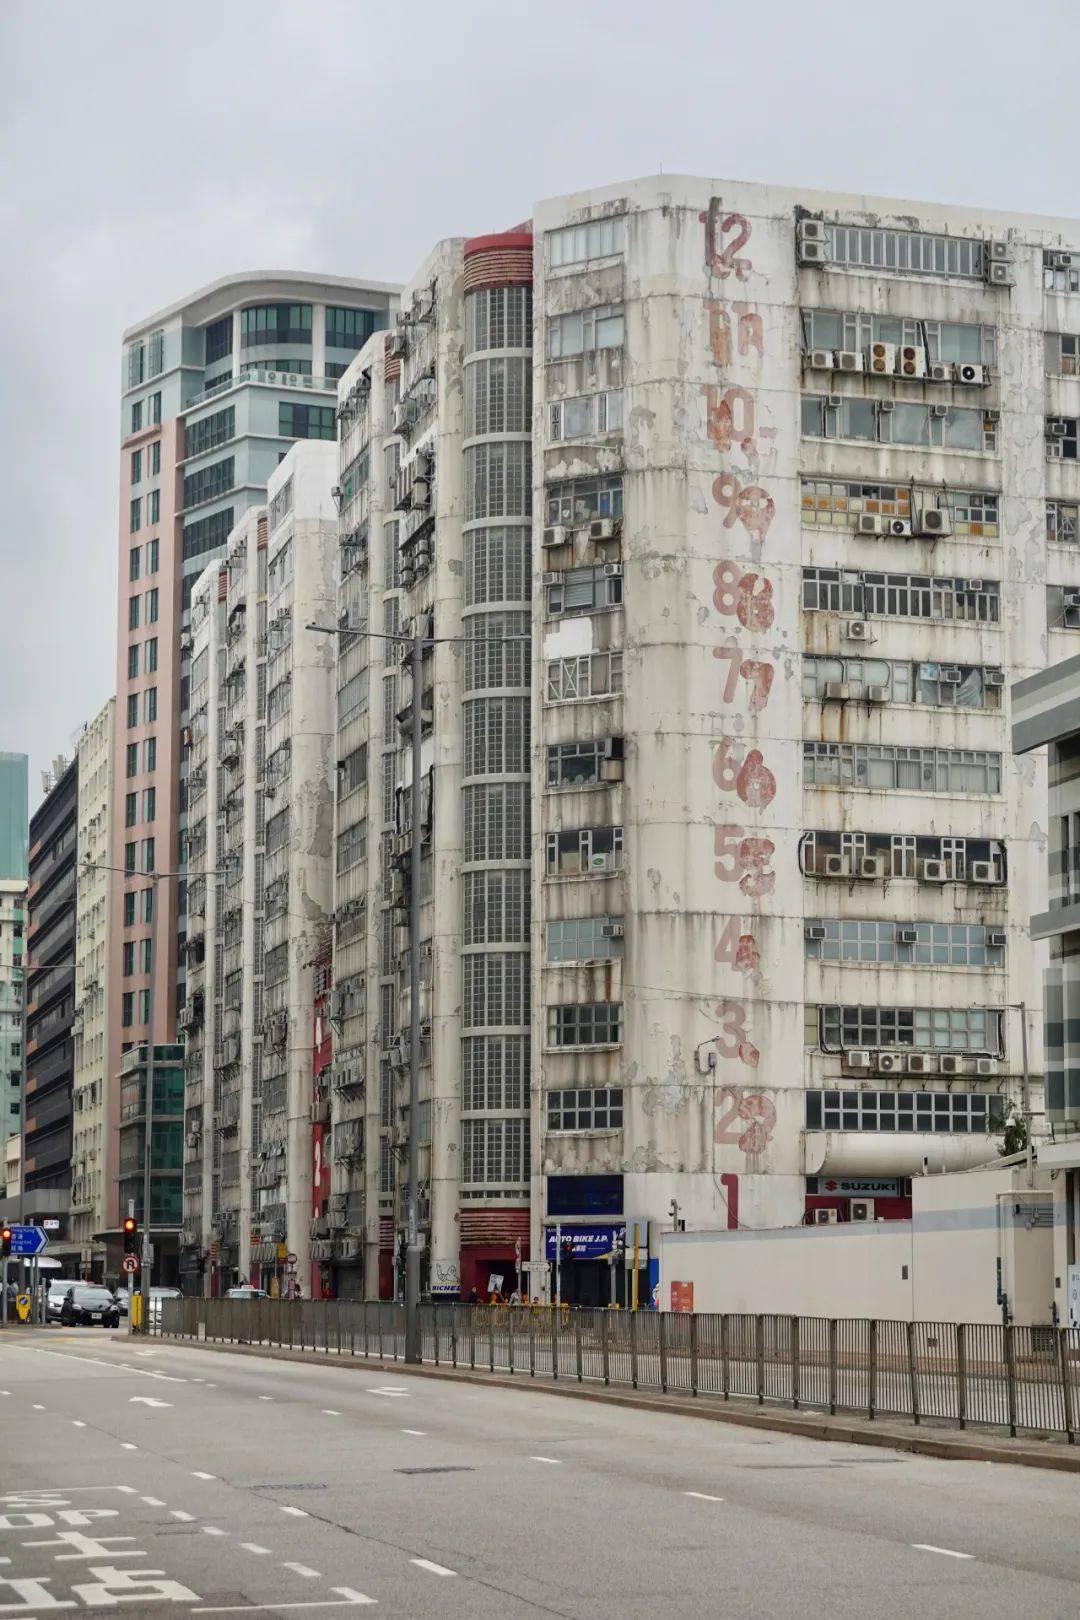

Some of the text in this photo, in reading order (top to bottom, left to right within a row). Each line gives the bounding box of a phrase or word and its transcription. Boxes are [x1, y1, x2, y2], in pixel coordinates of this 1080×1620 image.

[699, 211, 752, 268] 12
[720, 1173, 739, 1230] 1
[840, 1182, 896, 1191] SUZUKI
[573, 1235, 594, 1243] BIKE
